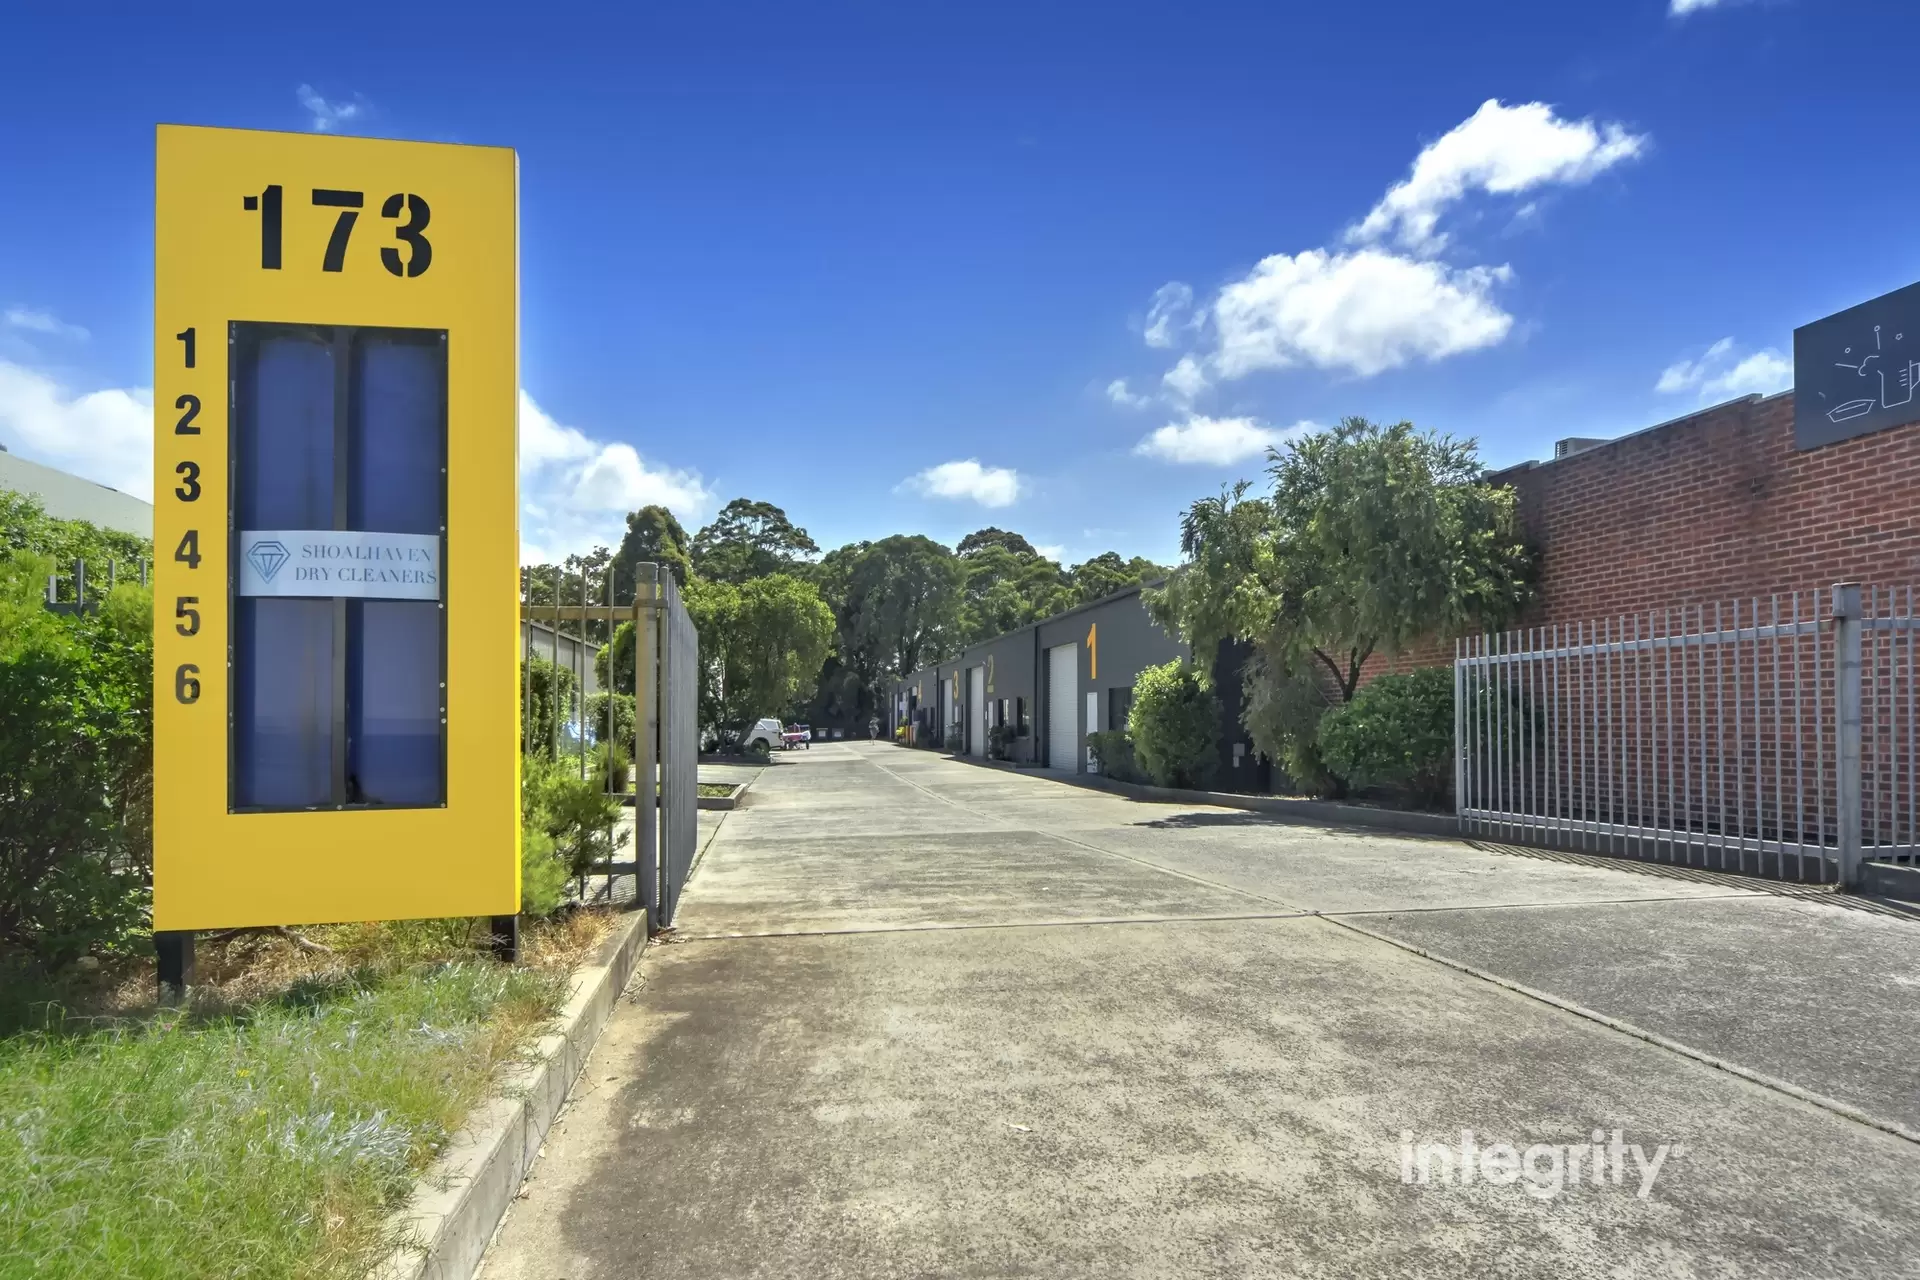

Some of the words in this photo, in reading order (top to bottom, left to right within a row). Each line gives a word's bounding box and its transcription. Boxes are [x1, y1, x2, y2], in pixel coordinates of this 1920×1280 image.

[244, 185, 433, 278] 173
[176, 328, 196, 369] 1
[175, 395, 201, 435] 2
[175, 461, 201, 502] 3
[175, 530, 202, 569] 4
[301, 544, 432, 562] SHOALHAVEN
[295, 567, 333, 581] DRY
[338, 567, 437, 584] CLEANERS
[175, 597, 201, 637] 5
[1086, 623, 1097, 680] 1
[175, 664, 201, 705] 6
